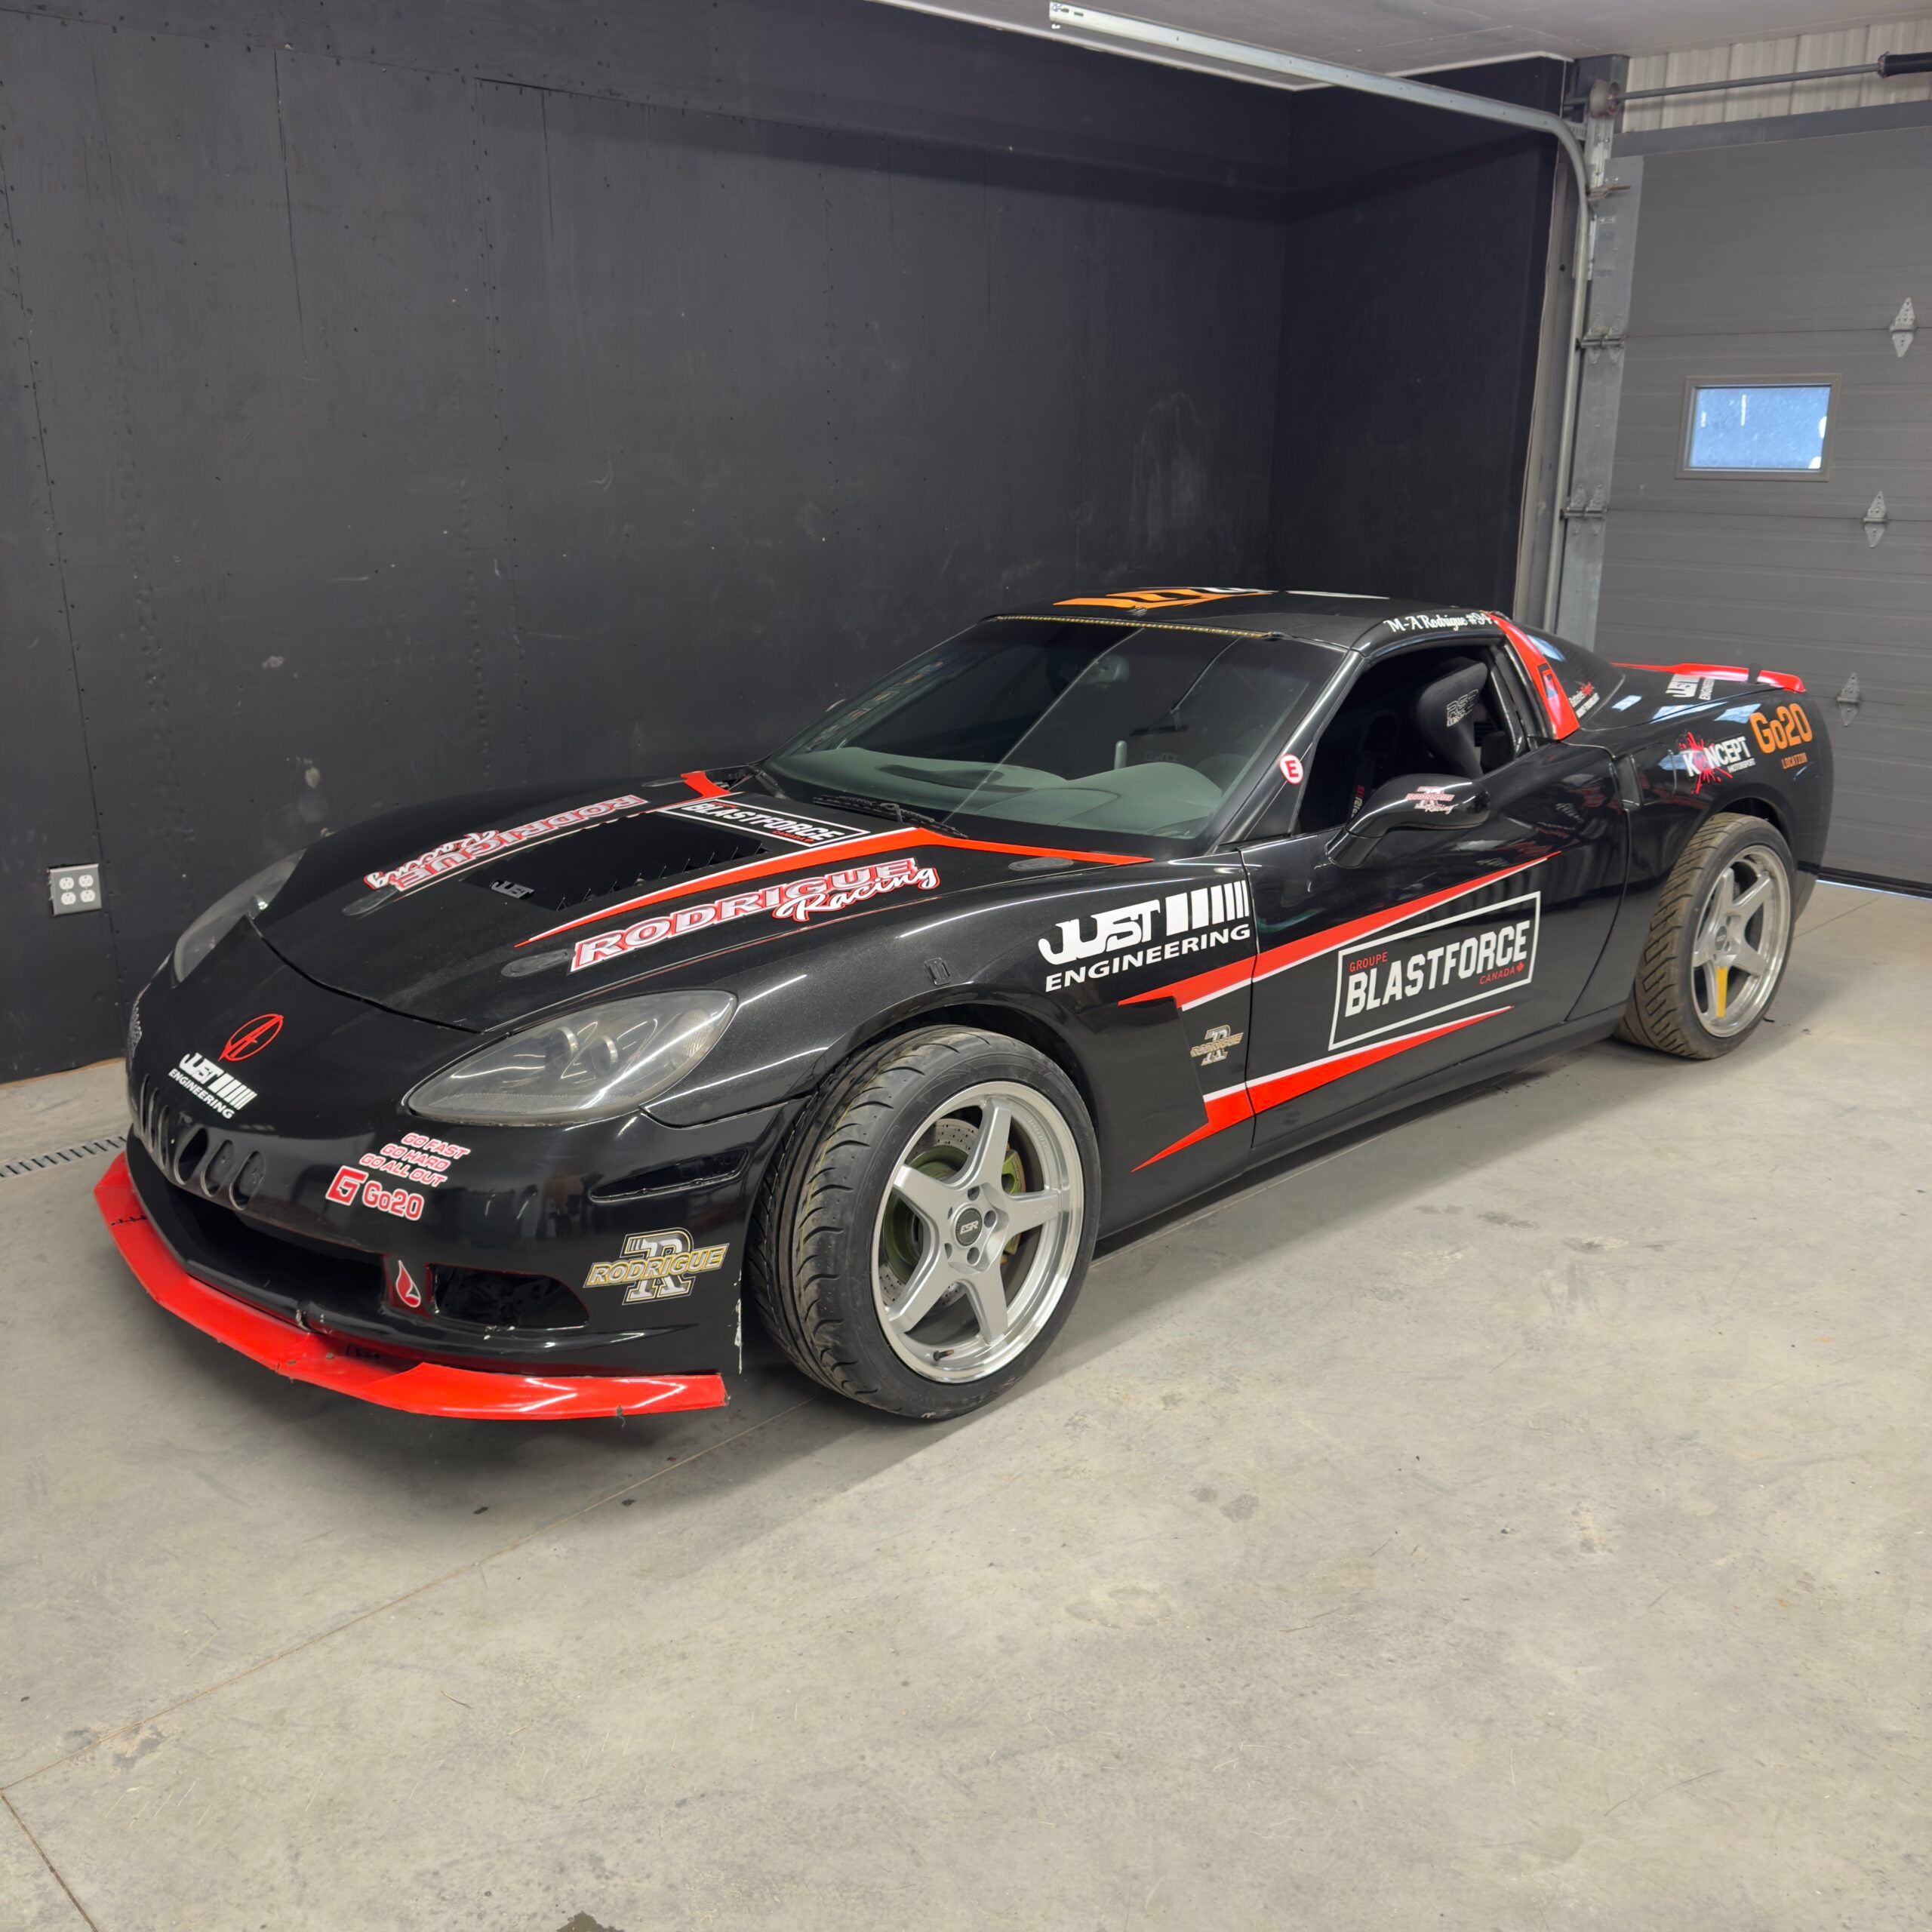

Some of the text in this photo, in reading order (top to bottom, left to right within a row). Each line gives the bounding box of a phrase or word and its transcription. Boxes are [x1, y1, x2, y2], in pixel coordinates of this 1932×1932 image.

[1383, 615, 1423, 632] M-A
[1417, 614, 1467, 632] Rodrigue
[1749, 703, 1813, 754] Go20
[1284, 760, 1299, 778] E
[1781, 752, 1808, 770] LOCATION
[1404, 792, 1456, 801] RODRIGUE
[1424, 803, 1455, 814] Racing
[681, 802, 846, 841] BLASTFORCE
[364, 830, 499, 889] Racing
[394, 795, 649, 891] RODRIGUE
[772, 867, 940, 921] Racing
[571, 857, 918, 972] RODRIGUE
[1038, 899, 1161, 965] JUST
[1045, 924, 1251, 992] ENGINEERING
[1345, 920, 1531, 1017] BLASTFORCE
[1349, 952, 1389, 973] GROUPE
[1478, 965, 1515, 985] CANADA
[179, 1052, 225, 1084] JUST
[168, 1068, 235, 1119] ENGINEERING
[380, 1143, 451, 1172] GO HARD
[401, 1132, 471, 1159] GO FAST
[358, 1153, 448, 1187] GO ALL OUT
[362, 1180, 424, 1221] Go20
[959, 1220, 980, 1235] ESR
[584, 1243, 729, 1287] RODRIGUE
